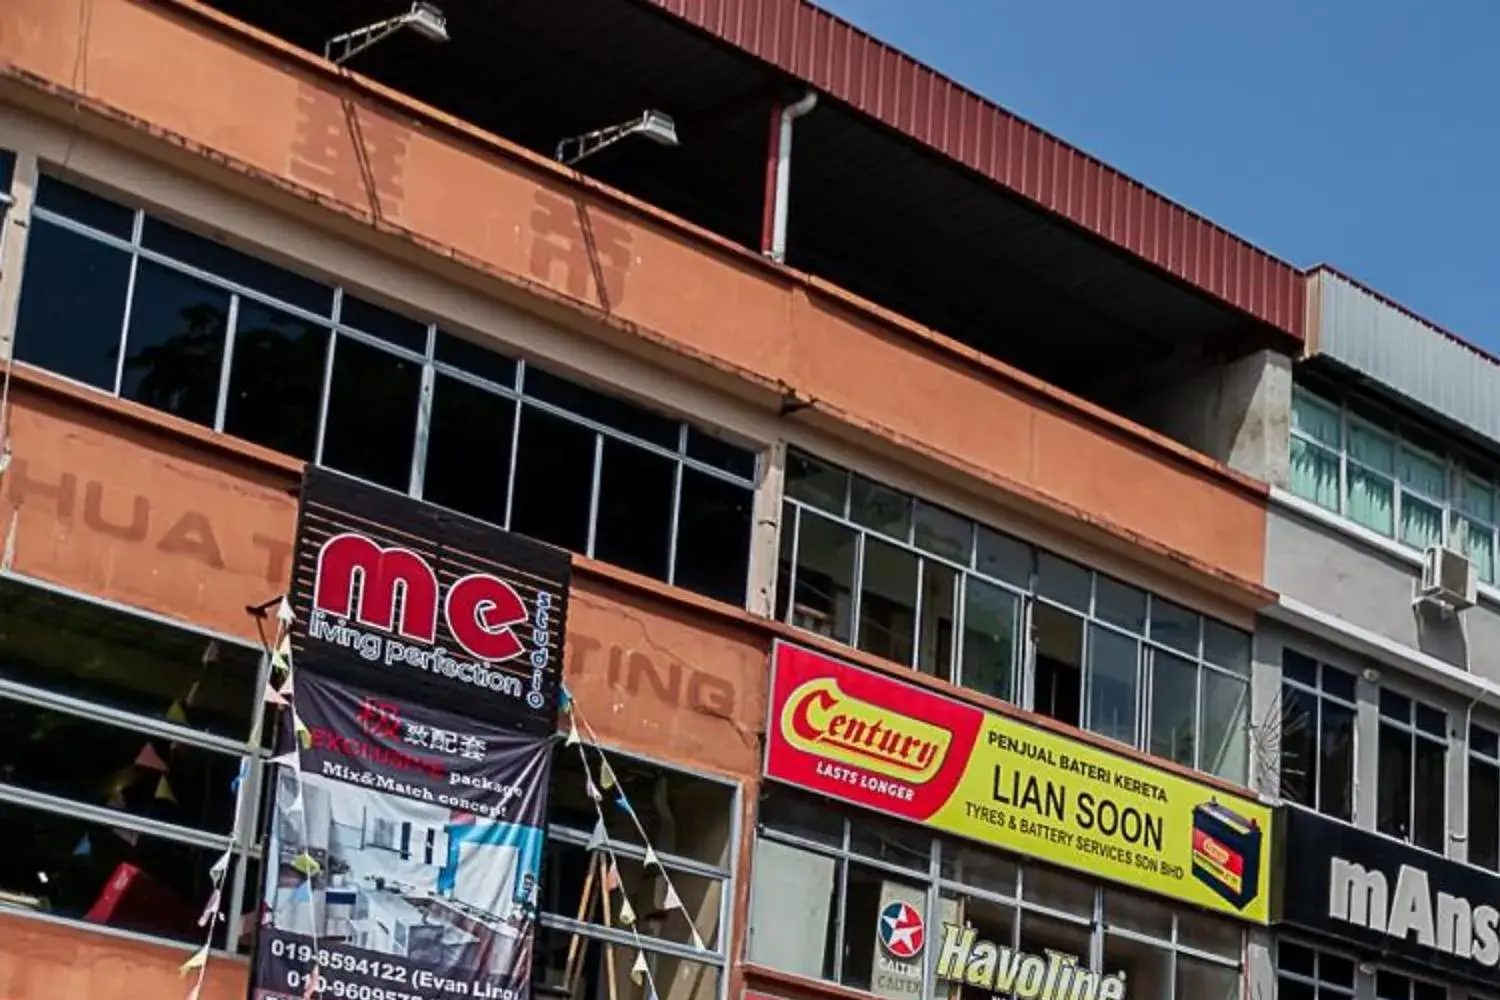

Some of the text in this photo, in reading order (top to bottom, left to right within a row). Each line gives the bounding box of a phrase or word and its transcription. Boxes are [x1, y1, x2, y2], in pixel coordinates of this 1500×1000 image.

[313, 532, 529, 662] me
[308, 608, 523, 699] living perfection
[526, 590, 551, 709] studio
[791, 687, 942, 772] Century
[988, 730, 1169, 803] PENJUAL BATERI KERETA
[322, 760, 508, 821] Mix&Match concept
[450, 771, 524, 800] package
[816, 760, 916, 802] LASTS LONGER
[992, 763, 1066, 822] LIAN
[1075, 791, 1164, 852] SOON
[965, 801, 1005, 826] TYRES
[1008, 813, 1017, 832] &
[1019, 815, 1074, 848] BATTERY
[1075, 835, 1134, 868] SERVICES
[1134, 852, 1159, 875] SDN
[1160, 860, 1185, 882] BHD
[271, 938, 408, 984] 019-8594122
[411, 970, 469, 996] (Evan
